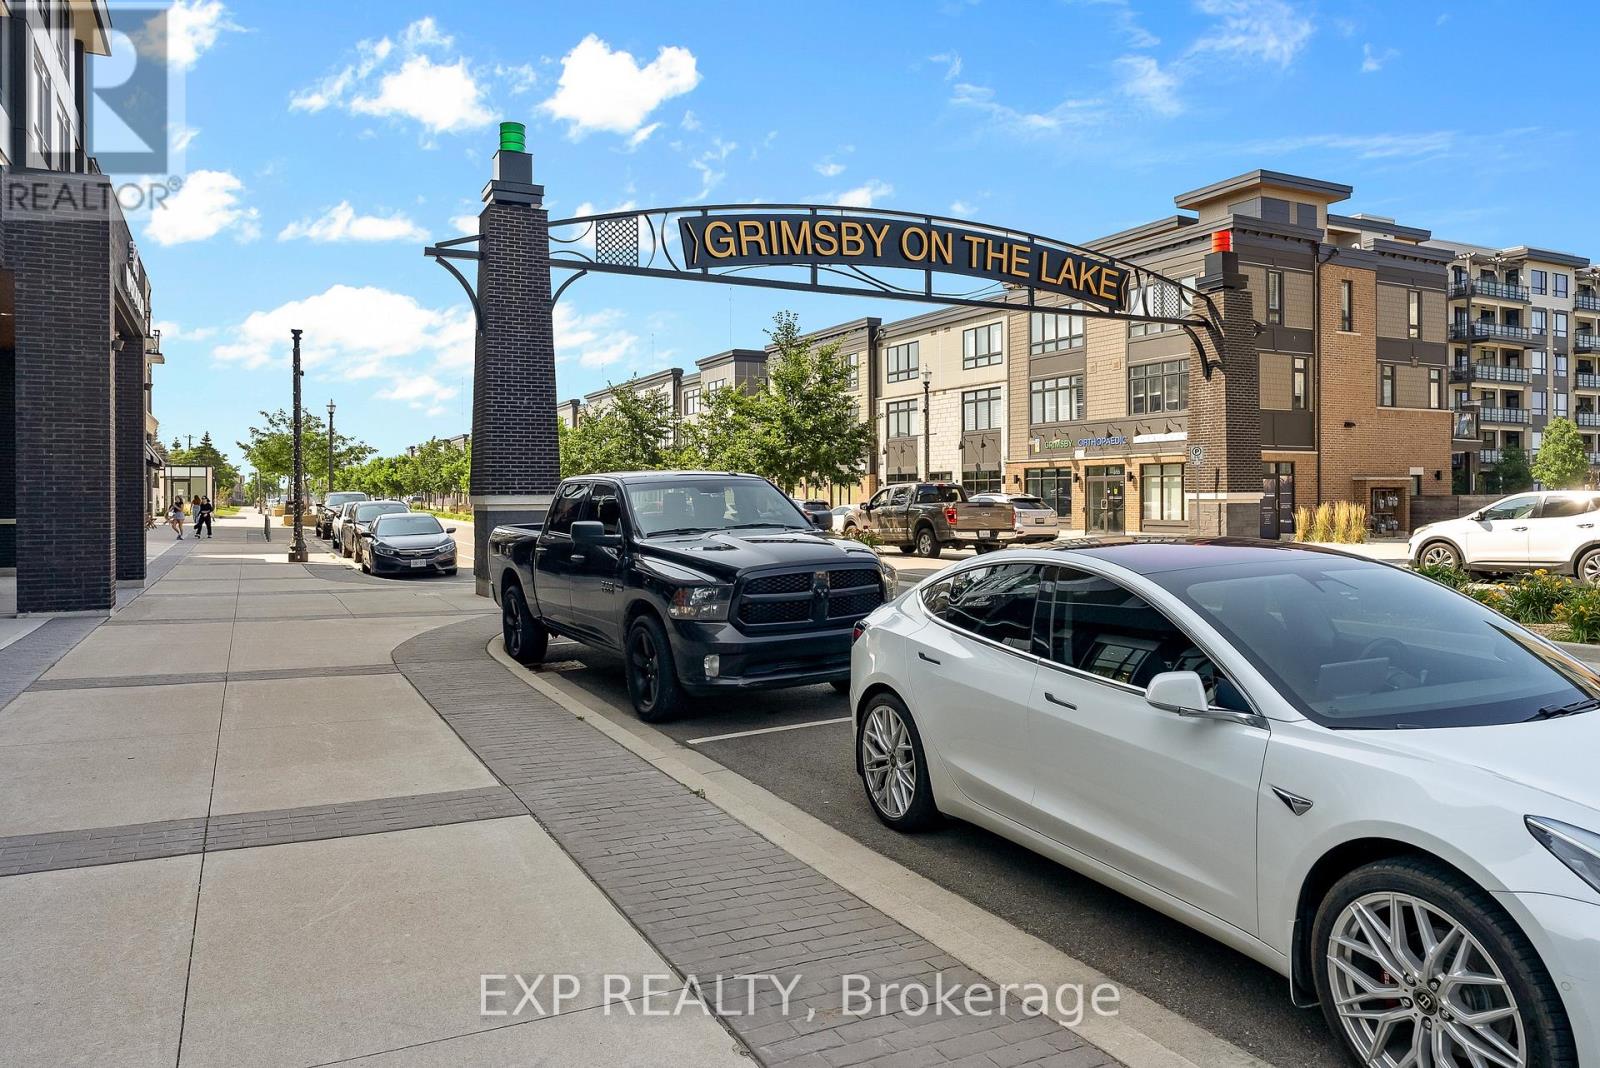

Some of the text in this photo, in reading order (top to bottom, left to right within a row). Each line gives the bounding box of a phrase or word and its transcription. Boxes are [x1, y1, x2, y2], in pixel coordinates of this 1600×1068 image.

[704, 220, 1120, 300] GRIMSBY ON THE LAKE
